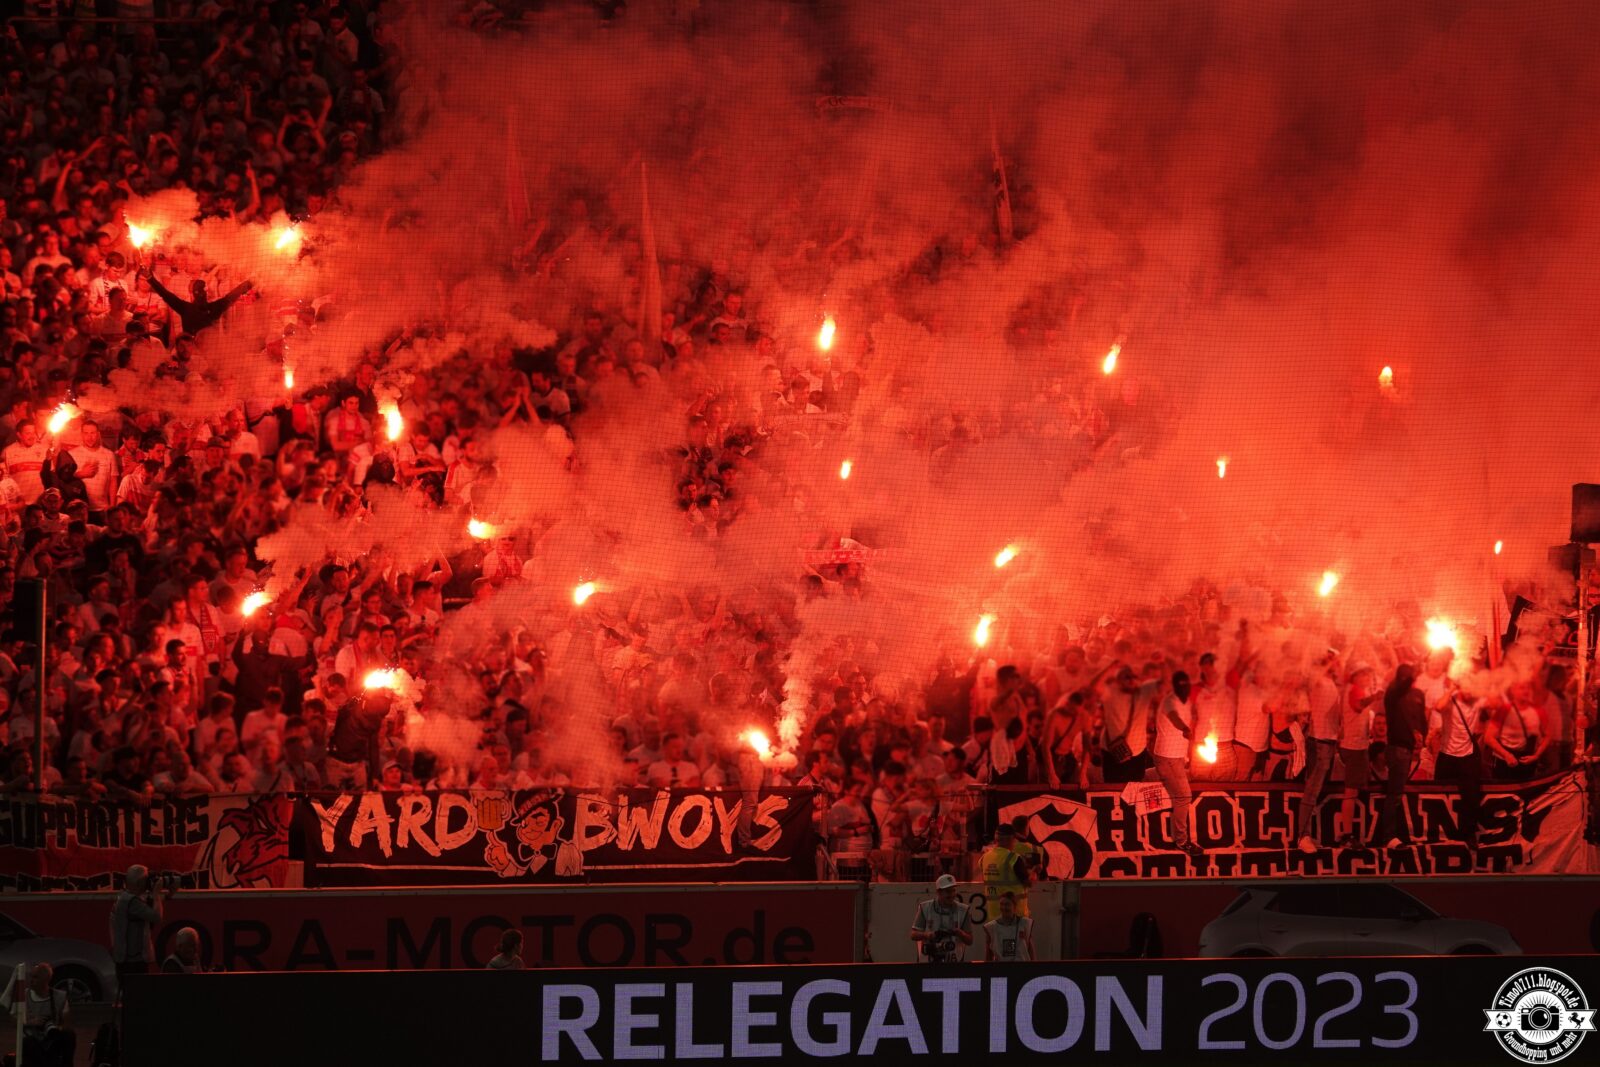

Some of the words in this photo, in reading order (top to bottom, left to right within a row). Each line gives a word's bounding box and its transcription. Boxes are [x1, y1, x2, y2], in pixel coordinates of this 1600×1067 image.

[311, 791, 478, 858] YARD
[576, 789, 790, 854] BWOYS
[1088, 793, 1523, 851] HOOLIGANS
[156, 909, 815, 972] ORA-MOTOR.de
[542, 976, 1162, 1060] RELEGATION
[1199, 972, 1418, 1049] 2023
